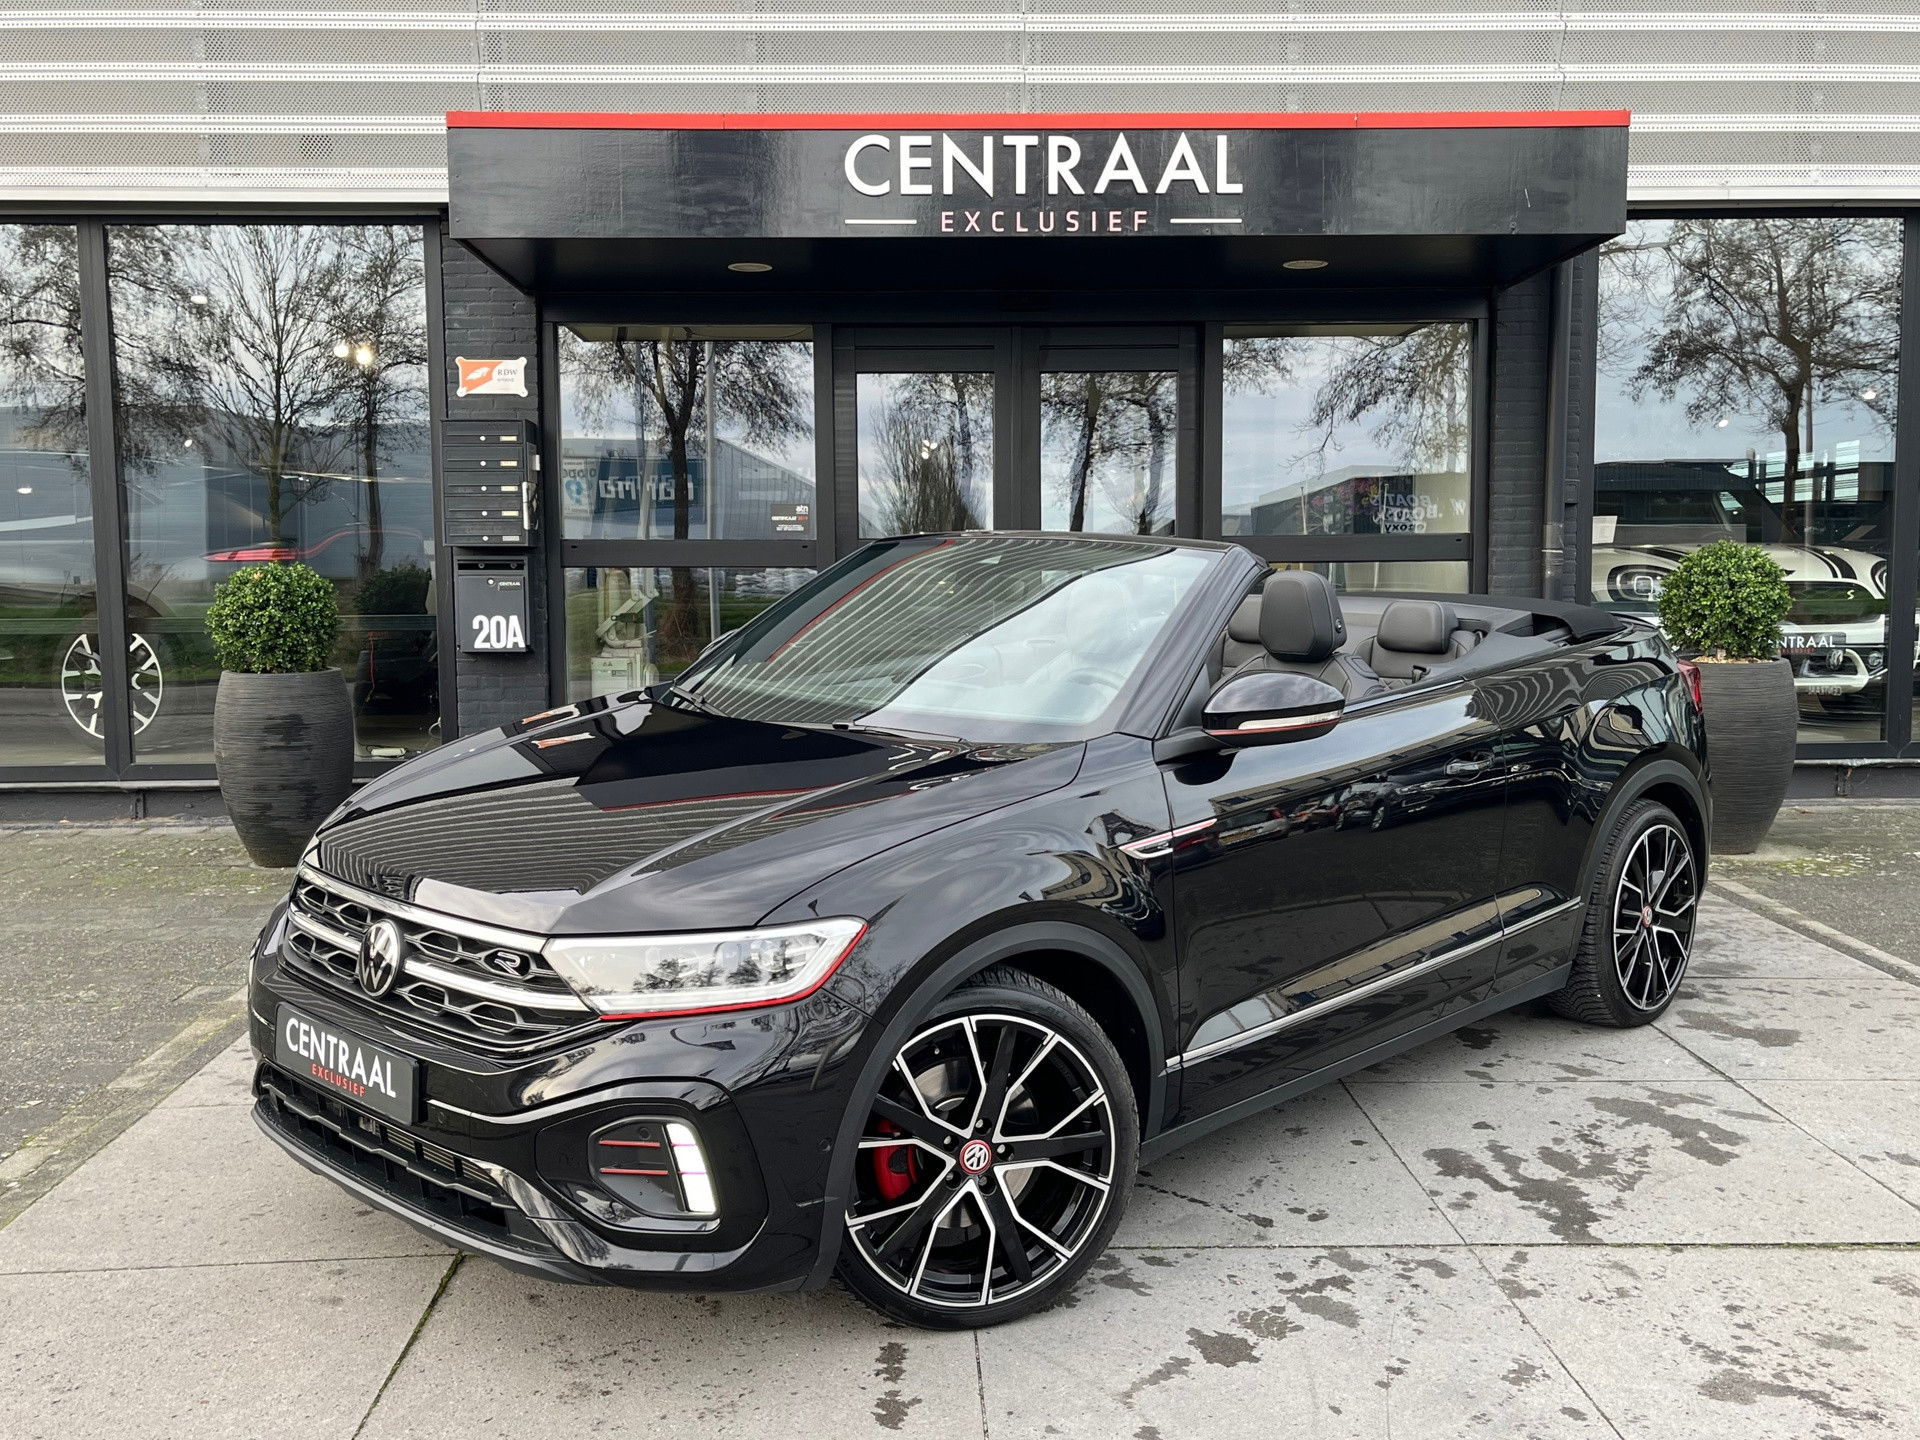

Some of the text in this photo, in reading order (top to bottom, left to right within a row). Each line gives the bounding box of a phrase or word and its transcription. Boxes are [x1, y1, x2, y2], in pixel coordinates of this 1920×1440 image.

[844, 131, 1244, 197] CENTRAAL
[941, 210, 1148, 232] EXCLUSIEF
[472, 614, 526, 649] 20A
[286, 1017, 397, 1098] CENTRAAL
[311, 1063, 366, 1097] EXCLUSIEF
